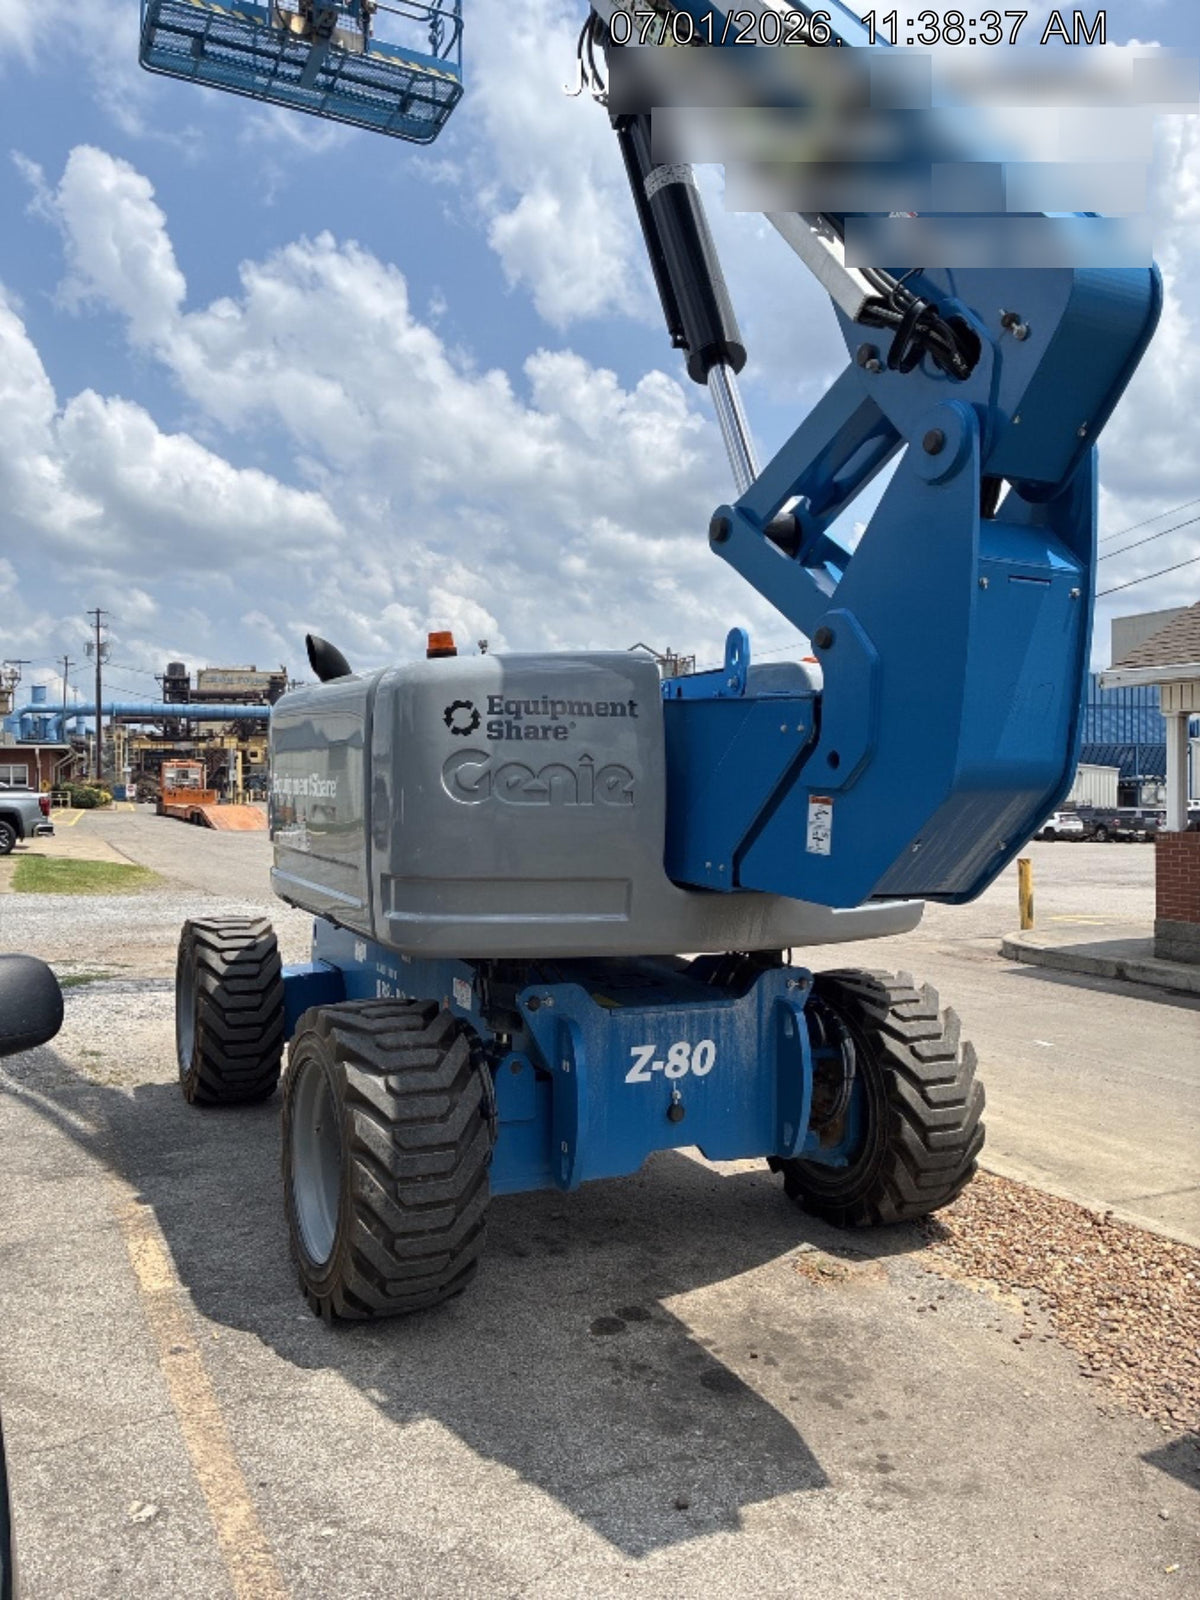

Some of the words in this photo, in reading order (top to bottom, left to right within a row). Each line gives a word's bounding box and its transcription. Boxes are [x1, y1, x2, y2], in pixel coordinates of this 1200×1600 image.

[486, 695, 639, 720] Equipment
[440, 748, 634, 805] Genie
[624, 1039, 716, 1083] Z-80
